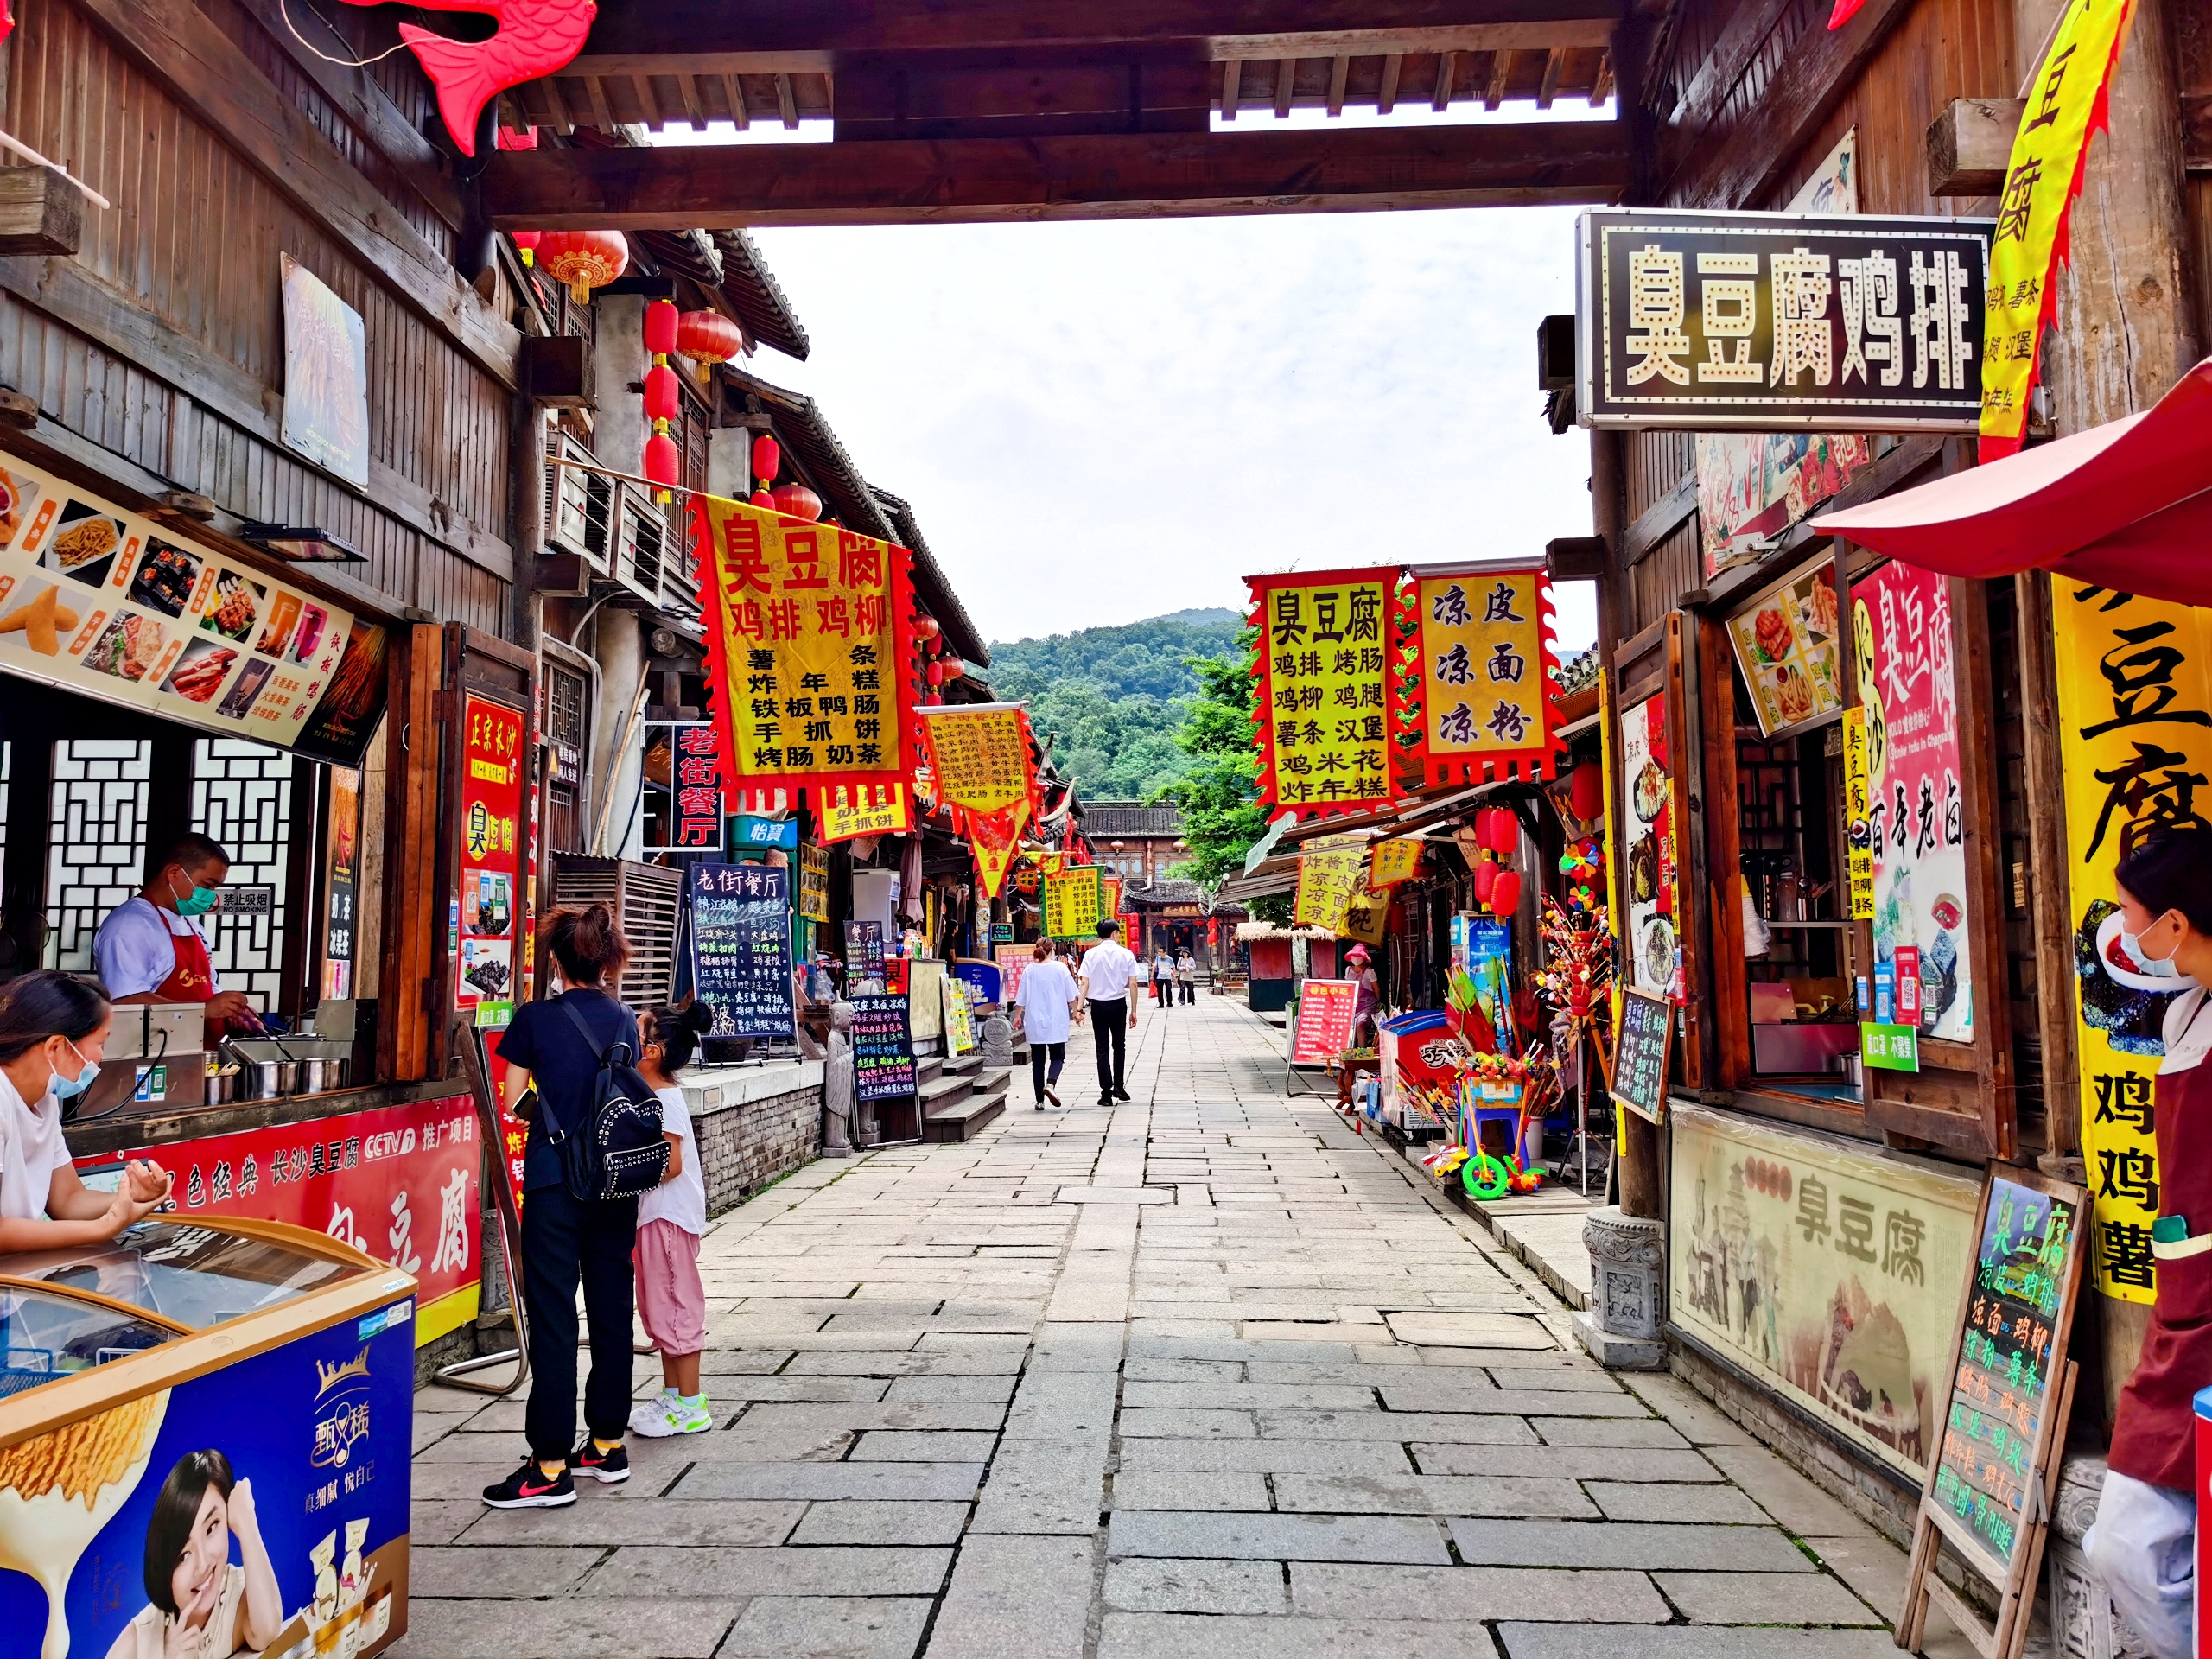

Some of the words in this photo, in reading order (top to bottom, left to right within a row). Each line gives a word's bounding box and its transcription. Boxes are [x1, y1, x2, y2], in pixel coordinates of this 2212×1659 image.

[2008, 276, 2040, 309] 薯条
[1625, 244, 1973, 390] 臭豆腐鸡排
[2005, 330, 2032, 361] 汉堡
[723, 512, 884, 594] 臭豆腐
[730, 597, 803, 642] 鸡排
[816, 594, 887, 639] 鸡柳
[1271, 585, 1382, 646] 臭豆腐
[1433, 582, 1525, 627] 凉皮
[1272, 650, 1324, 678] 鸡排
[1332, 647, 1383, 676] 烤肠
[1878, 577, 1957, 717] 臭豆腐
[290, 631, 342, 721] 铁板鸭肠
[1435, 643, 1526, 687] 凉面
[270, 675, 300, 692] 百香果茶
[747, 668, 880, 695] 炸年糕
[1855, 609, 1884, 775] 长沙
[251, 705, 282, 722] 珍珠奶茶
[260, 691, 291, 708] 火龙果茶
[750, 694, 880, 719] 铁板鸭肠
[1274, 684, 1324, 713] 鸡柳
[1333, 683, 1385, 710] 鸡腿
[470, 713, 517, 759] 正宗长沙
[753, 718, 881, 744] 手抓饼
[1275, 721, 1326, 748] 薯条
[1334, 715, 1386, 744] 汉堡
[1440, 700, 1533, 745] 凉粉
[2073, 585, 2212, 864] 豆腐
[753, 747, 815, 768] 烤肠
[826, 743, 883, 766] 奶茶
[1278, 748, 1386, 777] 鸡米花
[1846, 724, 1866, 814] 臭豆腐
[678, 727, 718, 847] 老街餐厅
[945, 790, 988, 799] 红烧肥肠
[994, 789, 1024, 798] 卤牛肉
[1280, 777, 1388, 803] 炸年糕
[469, 803, 512, 855] 臭豆腐
[833, 814, 895, 835] 手抓饼
[1869, 773, 1962, 868] 百年老卤
[1304, 855, 1363, 874] 炸酱面
[1853, 856, 1872, 874] 鸡排
[696, 868, 779, 897] 老街餐厅
[1306, 887, 1350, 908] 凉面
[1308, 872, 1352, 892] 凉皮
[1853, 877, 1872, 893] 鸡柳
[223, 893, 268, 906] 禁止吸烟
[1074, 907, 1096, 916] 牛肉汤
[1853, 897, 1873, 914] 薯条
[751, 929, 779, 941] 大盘鸡
[851, 923, 874, 944] 餐厅
[1075, 916, 1097, 925] 盖浇饭
[751, 943, 779, 953] 红烧肉
[1310, 986, 1349, 995] 特色小吃
[1866, 1033, 1887, 1056] 戴口罩
[1890, 1035, 1912, 1059] 不聚集
[270, 1136, 361, 1186] 长沙臭豆腐
[422, 1116, 473, 1152] 推广项目
[1794, 1173, 1927, 1287] 臭豆腐
[1991, 1187, 2070, 1275] 臭豆腐
[1977, 1255, 2008, 1296] 凉皮
[2021, 1269, 2056, 1315] 鸡排
[1971, 1294, 2003, 1336] 凉面
[2013, 1315, 2049, 1368] 鸡柳
[1964, 1328, 1995, 1370] 凉粉
[2004, 1350, 2039, 1399] 薯条
[304, 1478, 339, 1516] 真细腻
[344, 1459, 375, 1495] 悦自己
[1982, 1464, 2017, 1512] 鸡米花
